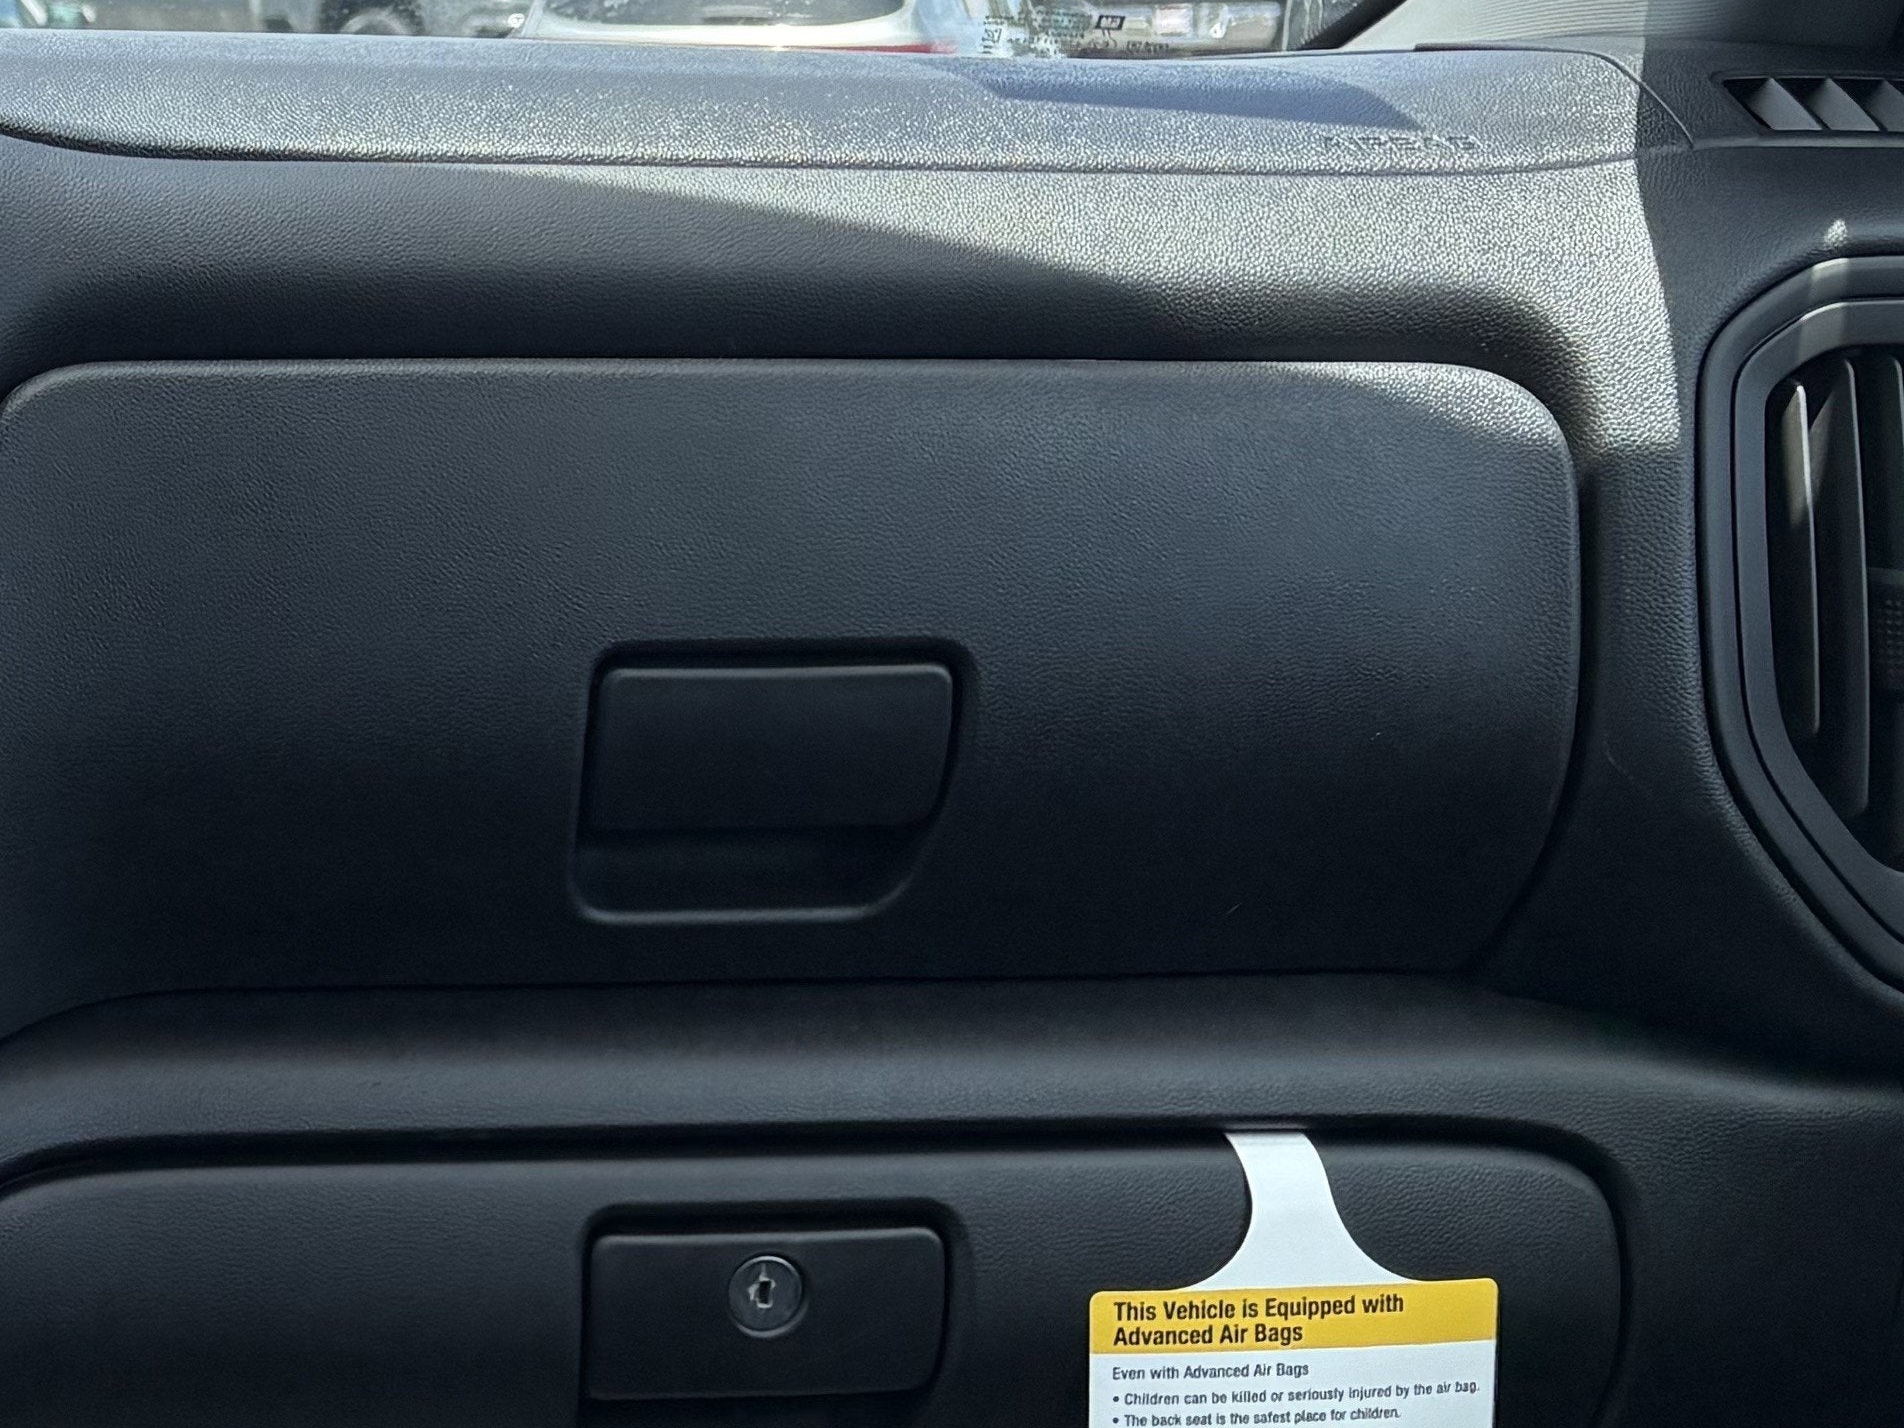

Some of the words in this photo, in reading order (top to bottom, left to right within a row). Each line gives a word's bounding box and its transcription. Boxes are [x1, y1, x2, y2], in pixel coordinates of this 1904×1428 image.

[1114, 1299, 1156, 1321] This
[1164, 1298, 1235, 1320] Vehicle
[1242, 1297, 1258, 1318] is
[1265, 1295, 1355, 1321] Equipped
[1362, 1294, 1404, 1314] with
[1113, 1323, 1213, 1346] Advanced
[1219, 1323, 1248, 1344] Air
[1254, 1322, 1303, 1346] Bags
[1112, 1366, 1145, 1380] Even
[1150, 1365, 1179, 1380] with
[1183, 1364, 1250, 1379] Advanced
[1254, 1364, 1272, 1378] Air
[1276, 1363, 1309, 1378] Bags
[1125, 1391, 1179, 1406] Children
[1184, 1394, 1207, 1405] can
[1211, 1391, 1227, 1404] be
[1231, 1390, 1266, 1403] killed
[1271, 1392, 1284, 1402] or
[1288, 1387, 1344, 1404] seriously
[1348, 1385, 1391, 1402] injured
[1395, 1384, 1409, 1399] by
[1414, 1382, 1432, 1396] the
[1436, 1381, 1451, 1394] air
[1455, 1380, 1480, 1396] bag.
[1125, 1414, 1147, 1427] The
[1151, 1413, 1182, 1426] back
[1186, 1413, 1212, 1425] seat
[1216, 1412, 1225, 1424] is
[1230, 1411, 1249, 1424] the
[1254, 1410, 1290, 1423] safest
[1295, 1410, 1326, 1425] place
[1330, 1409, 1346, 1420] for
